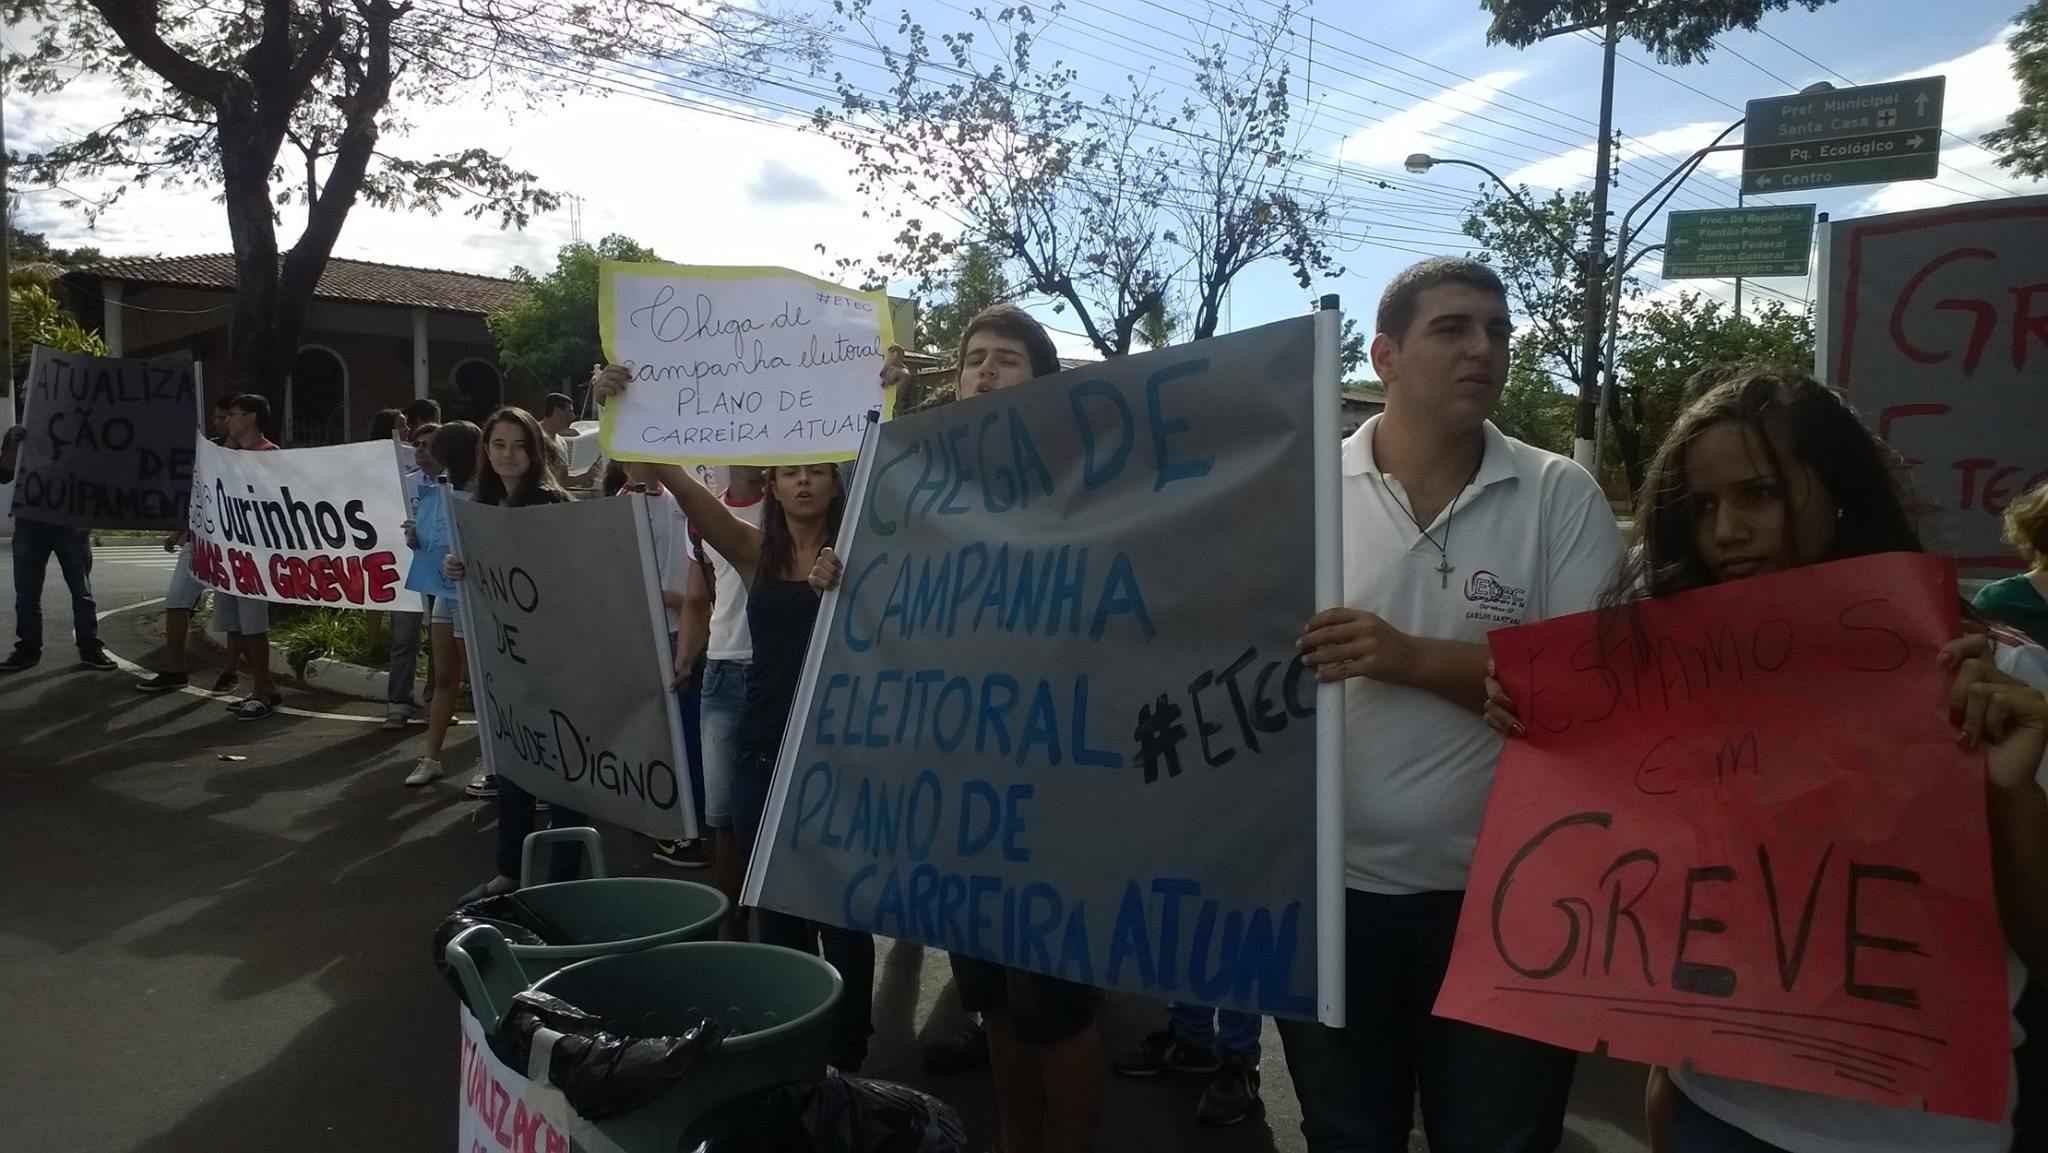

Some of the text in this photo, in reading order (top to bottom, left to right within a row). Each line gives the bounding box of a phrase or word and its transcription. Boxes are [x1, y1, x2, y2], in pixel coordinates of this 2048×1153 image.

[1777, 116, 1869, 136] Santa Casa
[1823, 93, 1899, 114] Municipal
[1790, 135, 1895, 161] Pq. Ecológico
[1782, 171, 1833, 186] Centro
[36, 358, 195, 405] ATUALIZA
[678, 387, 814, 417] PLANO DE
[641, 421, 769, 445] CARREIRA
[868, 356, 1220, 536] CHEGA DE
[216, 477, 378, 551] Ourinhos
[269, 550, 401, 605] GREVE
[844, 540, 1157, 653] CAMPANHA
[816, 669, 1124, 769] ELEITORAL
[1635, 731, 1761, 796] EM
[792, 760, 1034, 863] PLANO DE
[843, 863, 1094, 985] CARREIRA
[1491, 810, 1932, 1011] GREVE
